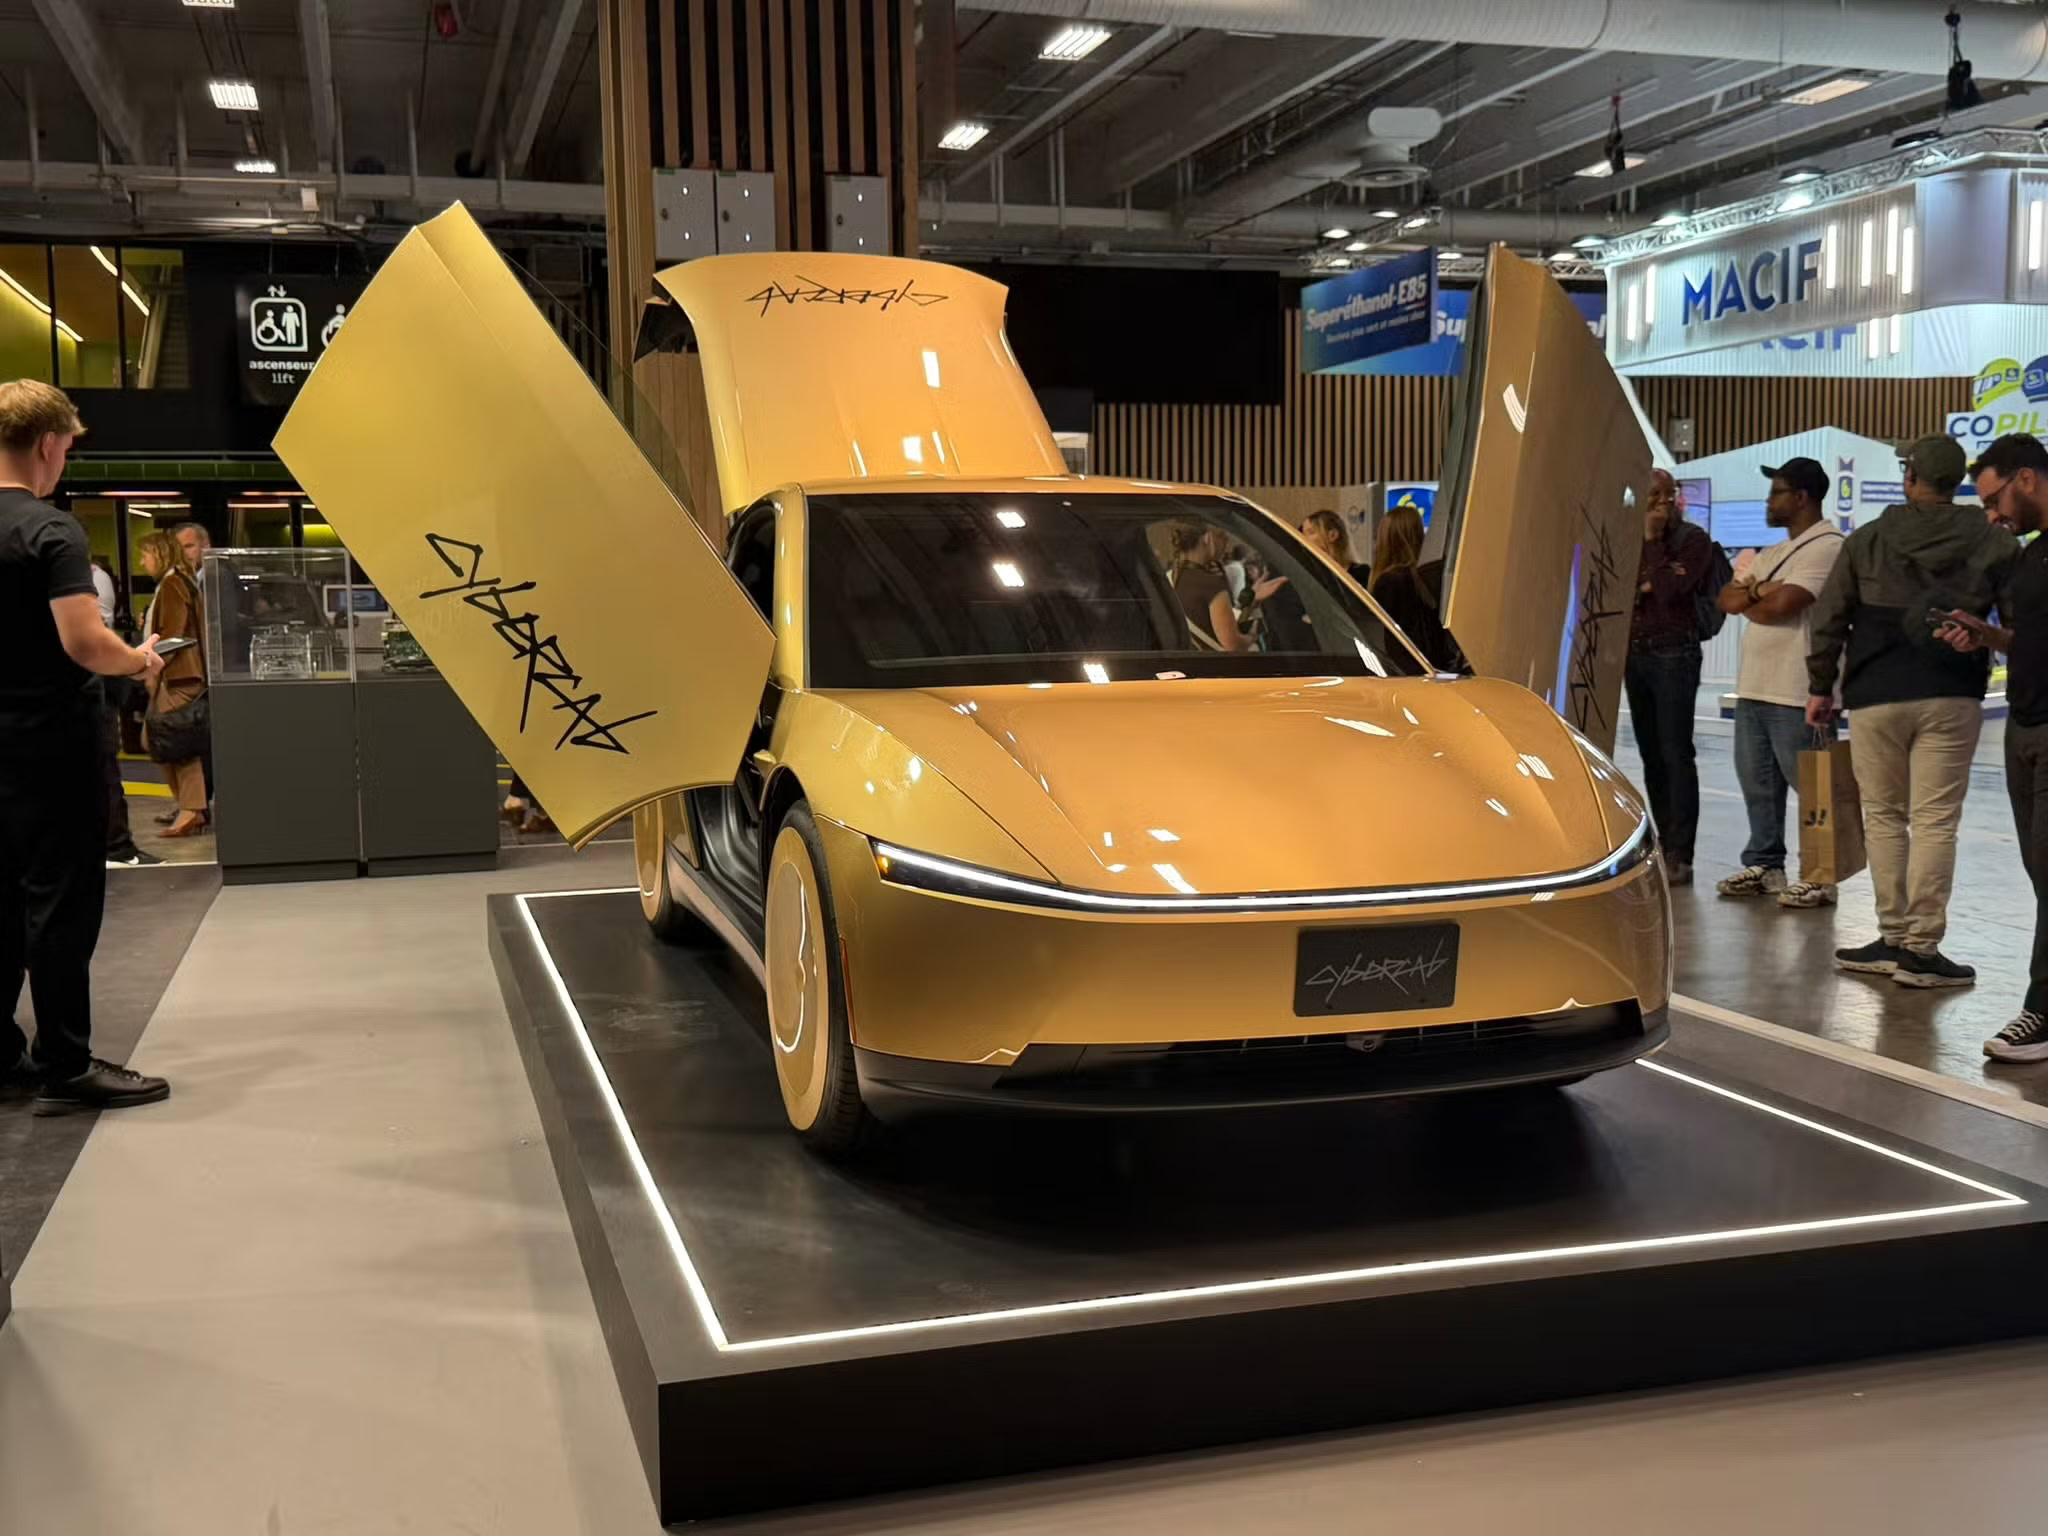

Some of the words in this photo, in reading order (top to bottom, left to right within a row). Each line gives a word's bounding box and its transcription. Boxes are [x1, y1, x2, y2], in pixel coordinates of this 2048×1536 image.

[1682, 239, 1822, 326] MACIF
[249, 360, 316, 371] ascenseur
[272, 372, 295, 384] lift
[1949, 412, 2048, 438] COPIL
